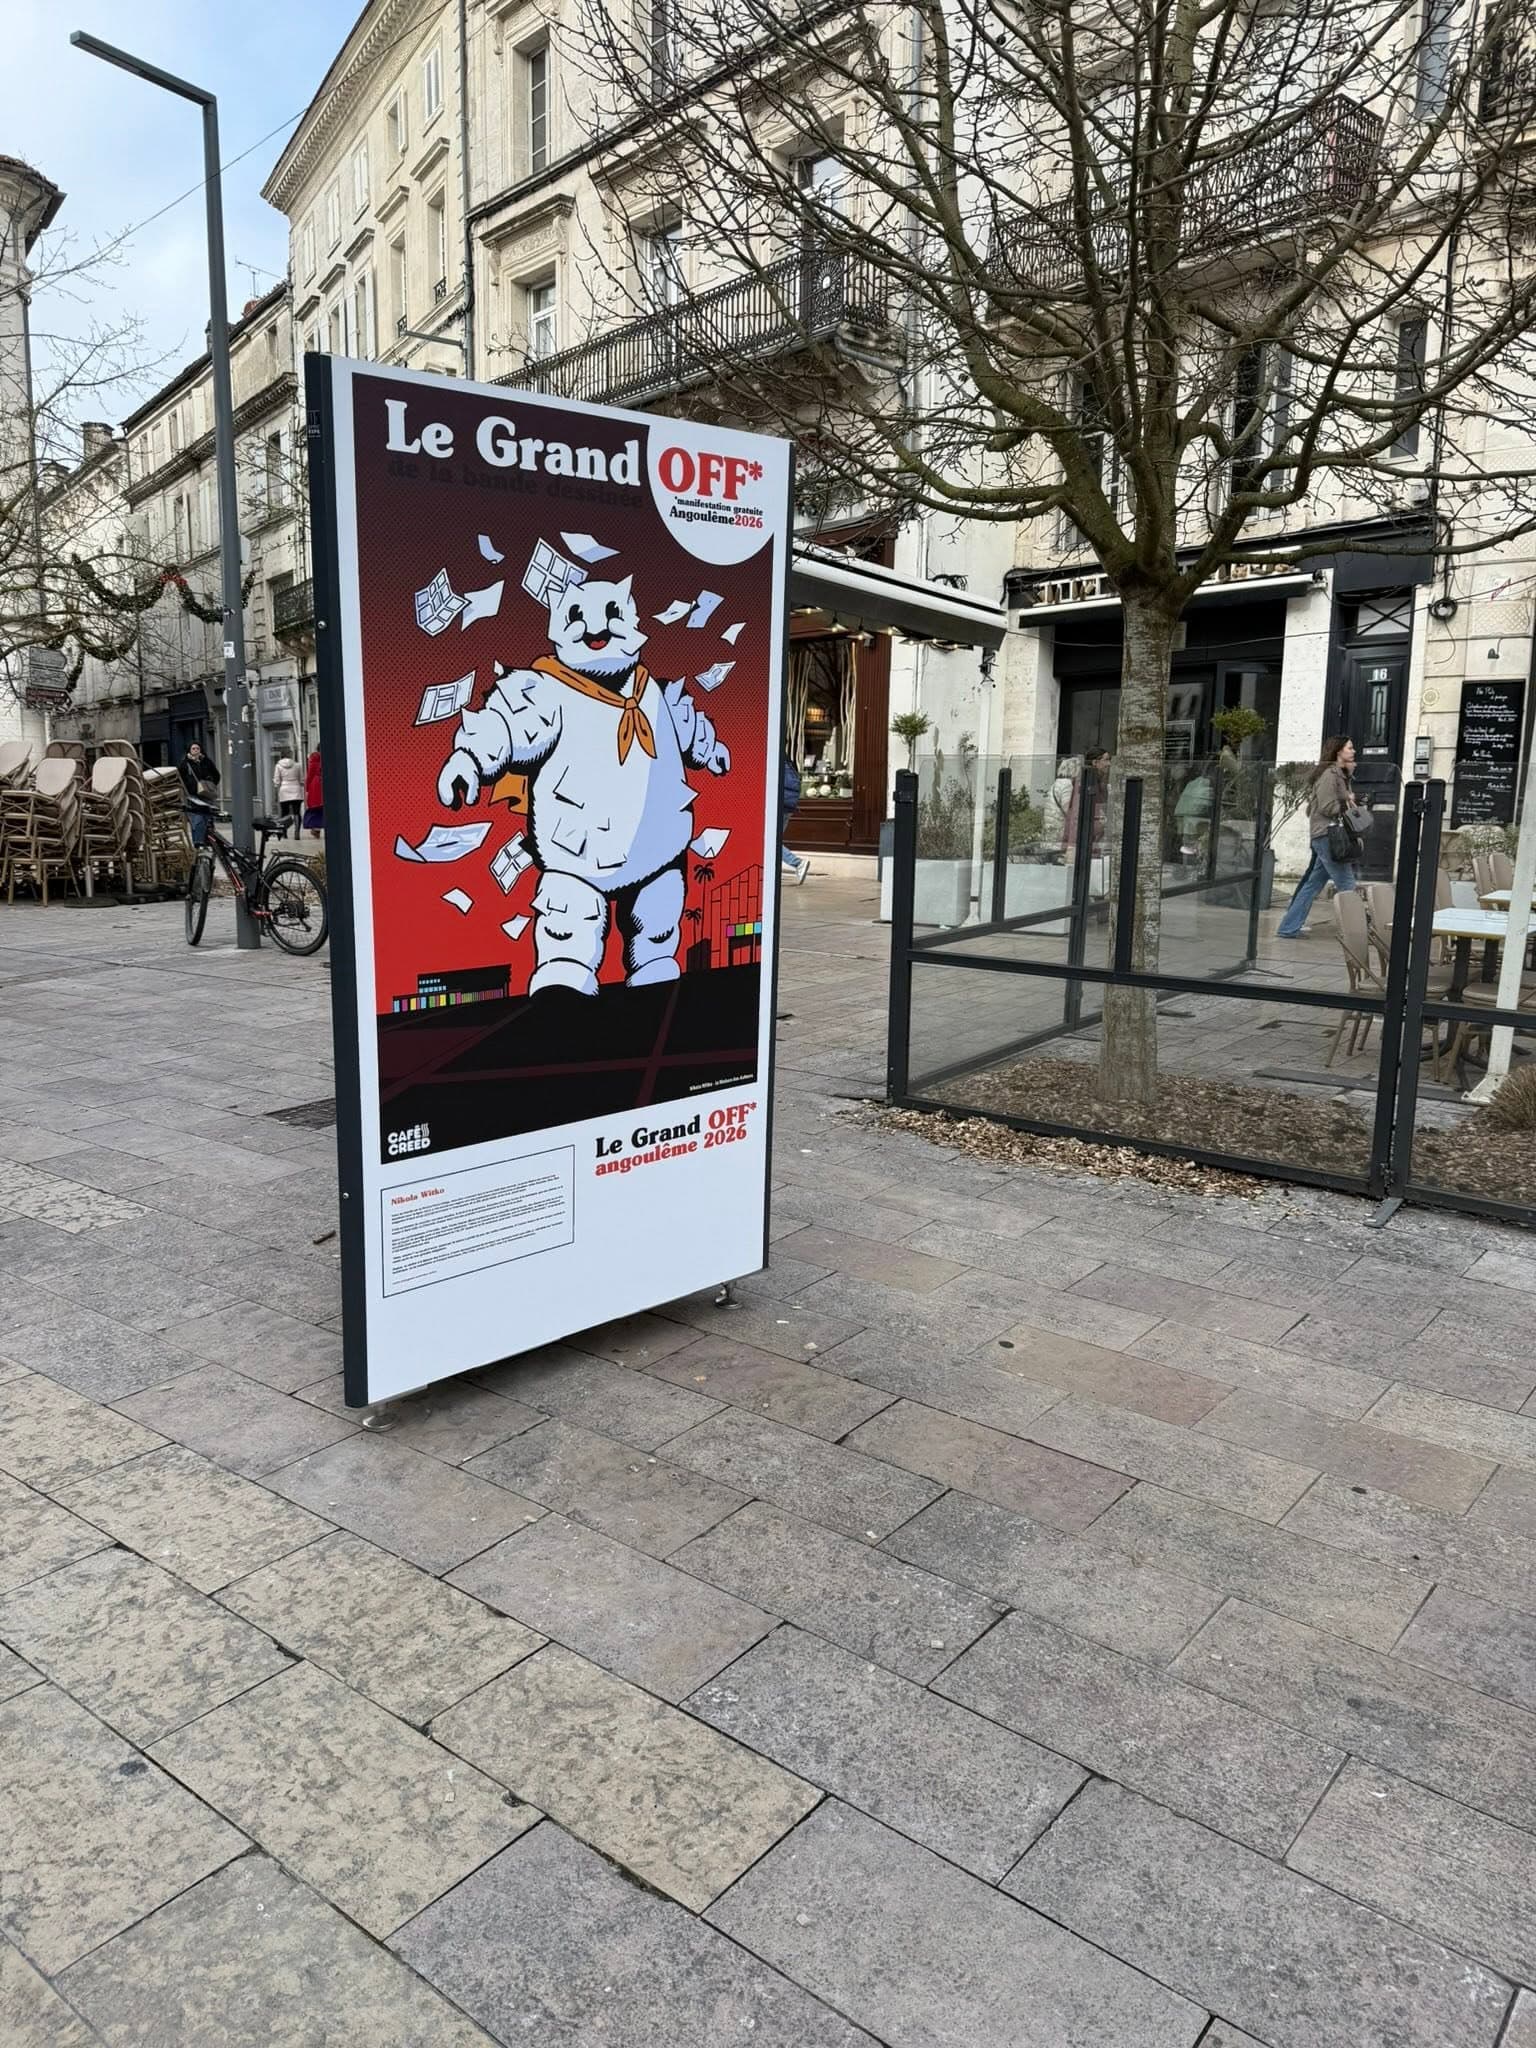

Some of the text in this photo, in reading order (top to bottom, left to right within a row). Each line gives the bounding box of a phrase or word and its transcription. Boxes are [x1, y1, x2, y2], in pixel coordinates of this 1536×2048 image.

[385, 398, 454, 458] Le
[476, 415, 641, 487] Grand
[733, 506, 763, 516] gratuite
[1372, 668, 1388, 681] 16
[388, 1124, 421, 1144] CAFÉ
[595, 1137, 623, 1158] Le
[631, 1114, 701, 1149] Grand
[388, 1137, 431, 1155] CREED
[595, 1124, 747, 1176] angoulême 2026
